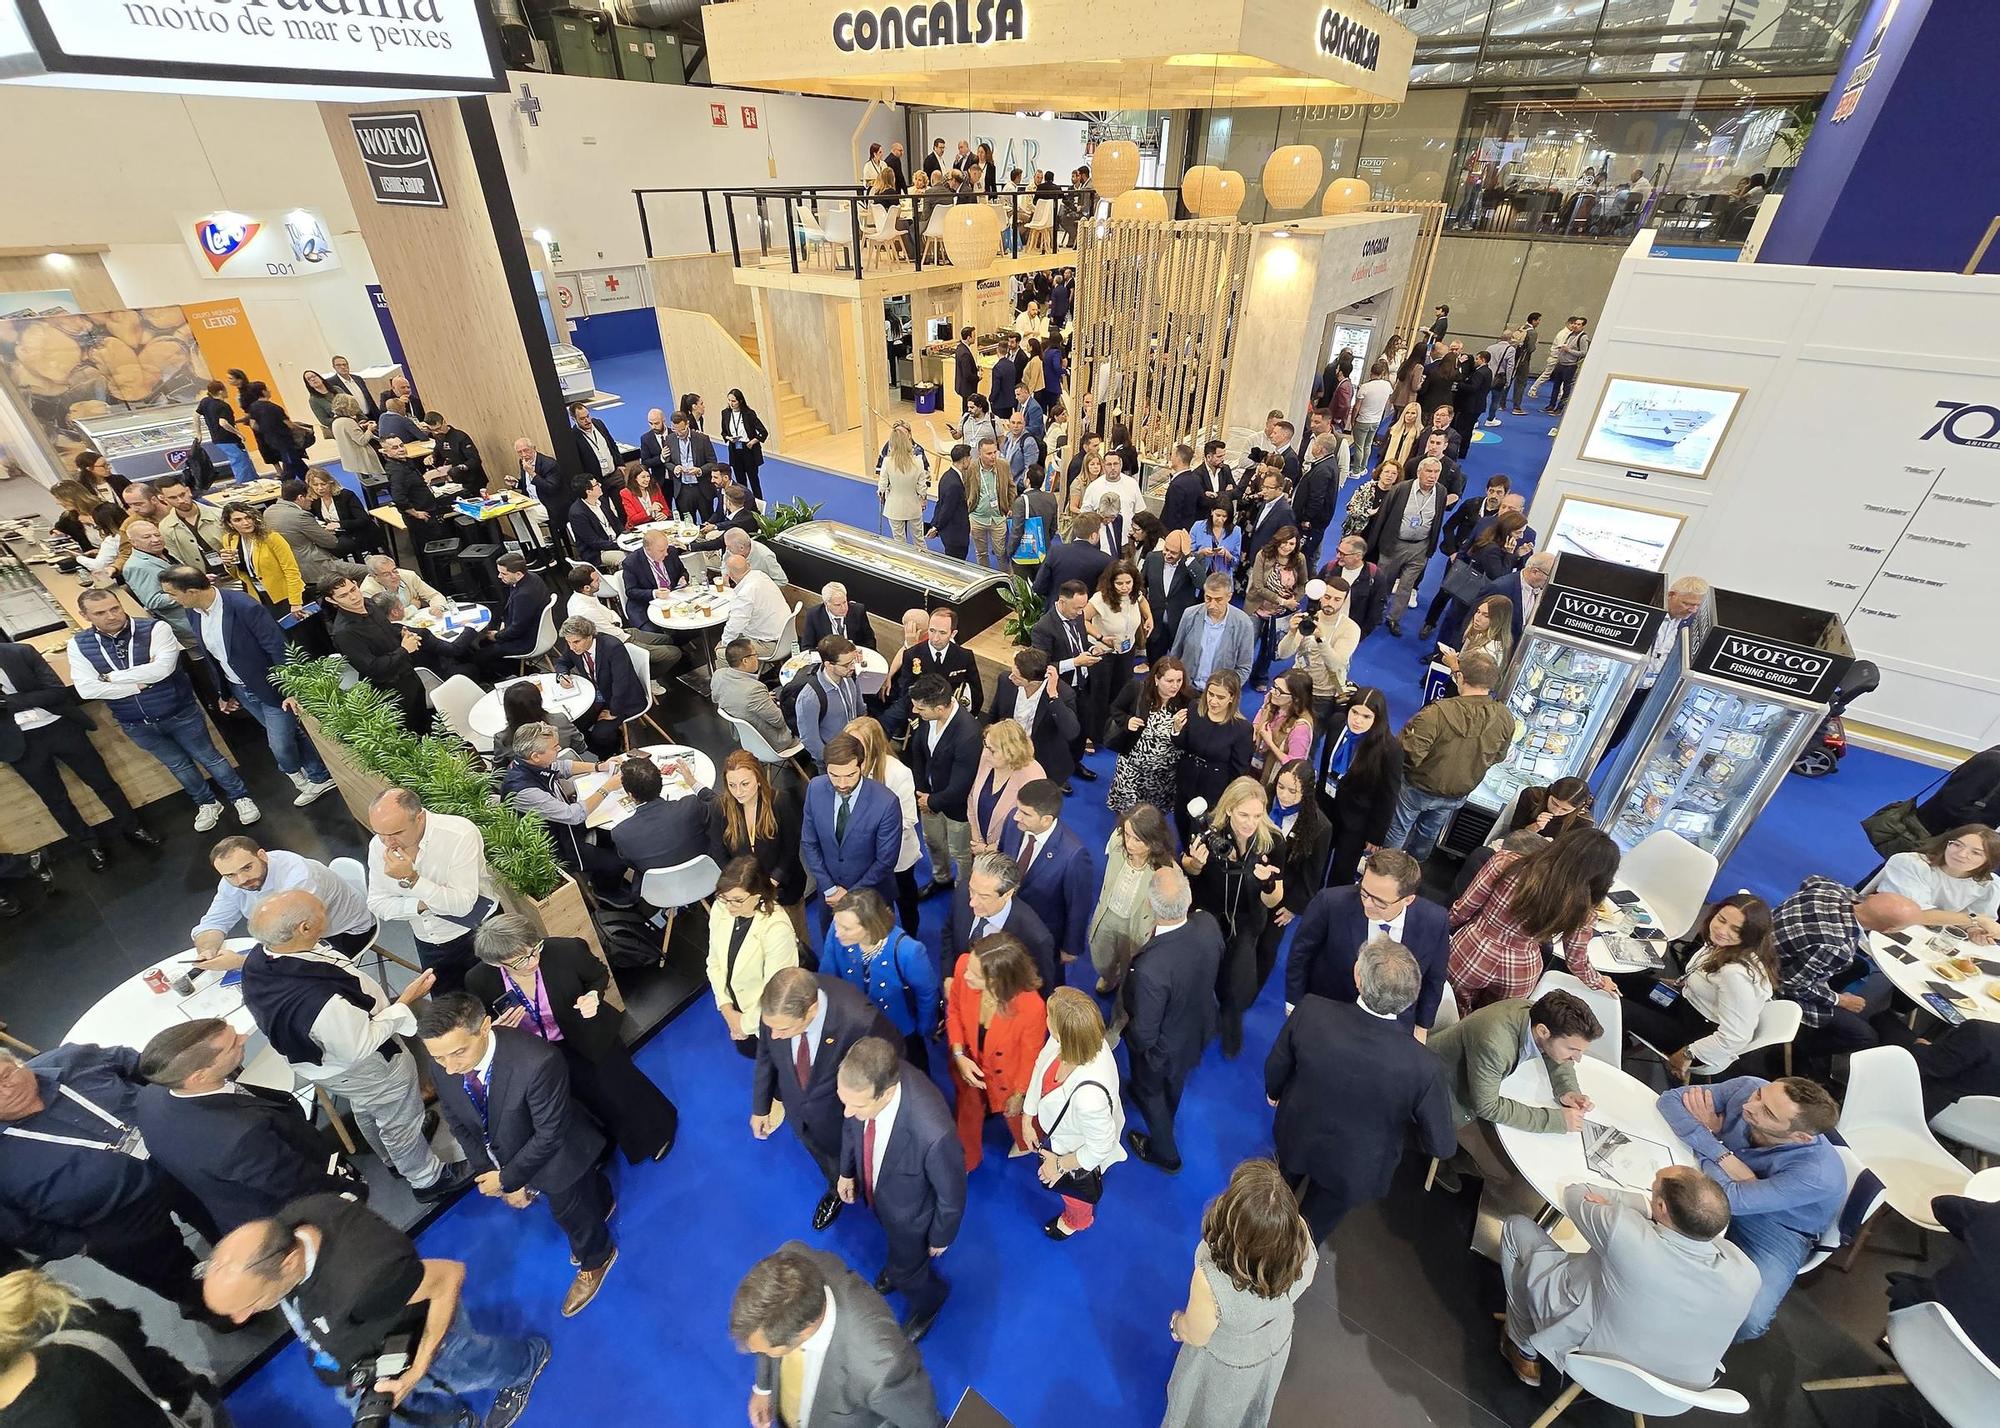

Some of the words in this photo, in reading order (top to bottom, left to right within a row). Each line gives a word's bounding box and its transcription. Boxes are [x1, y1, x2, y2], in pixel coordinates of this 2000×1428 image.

[122, 2, 230, 33] moito
[237, 6, 276, 38] de
[282, 18, 339, 42] mar
[347, 23, 363, 43] e
[368, 19, 453, 52] peixes
[833, 0, 1023, 52] CONGALSA
[1320, 8, 1380, 72] CONGALSA
[356, 127, 421, 155] WOFCO
[267, 263, 295, 276] D01
[1564, 597, 1640, 626] WOFCO
[1564, 617, 1594, 631] FISHING
[1594, 625, 1622, 638] GROUP
[1731, 641, 1821, 673] WOFCO
[1729, 662, 1765, 678] FISHING
[1765, 672, 1798, 685] GROUP
